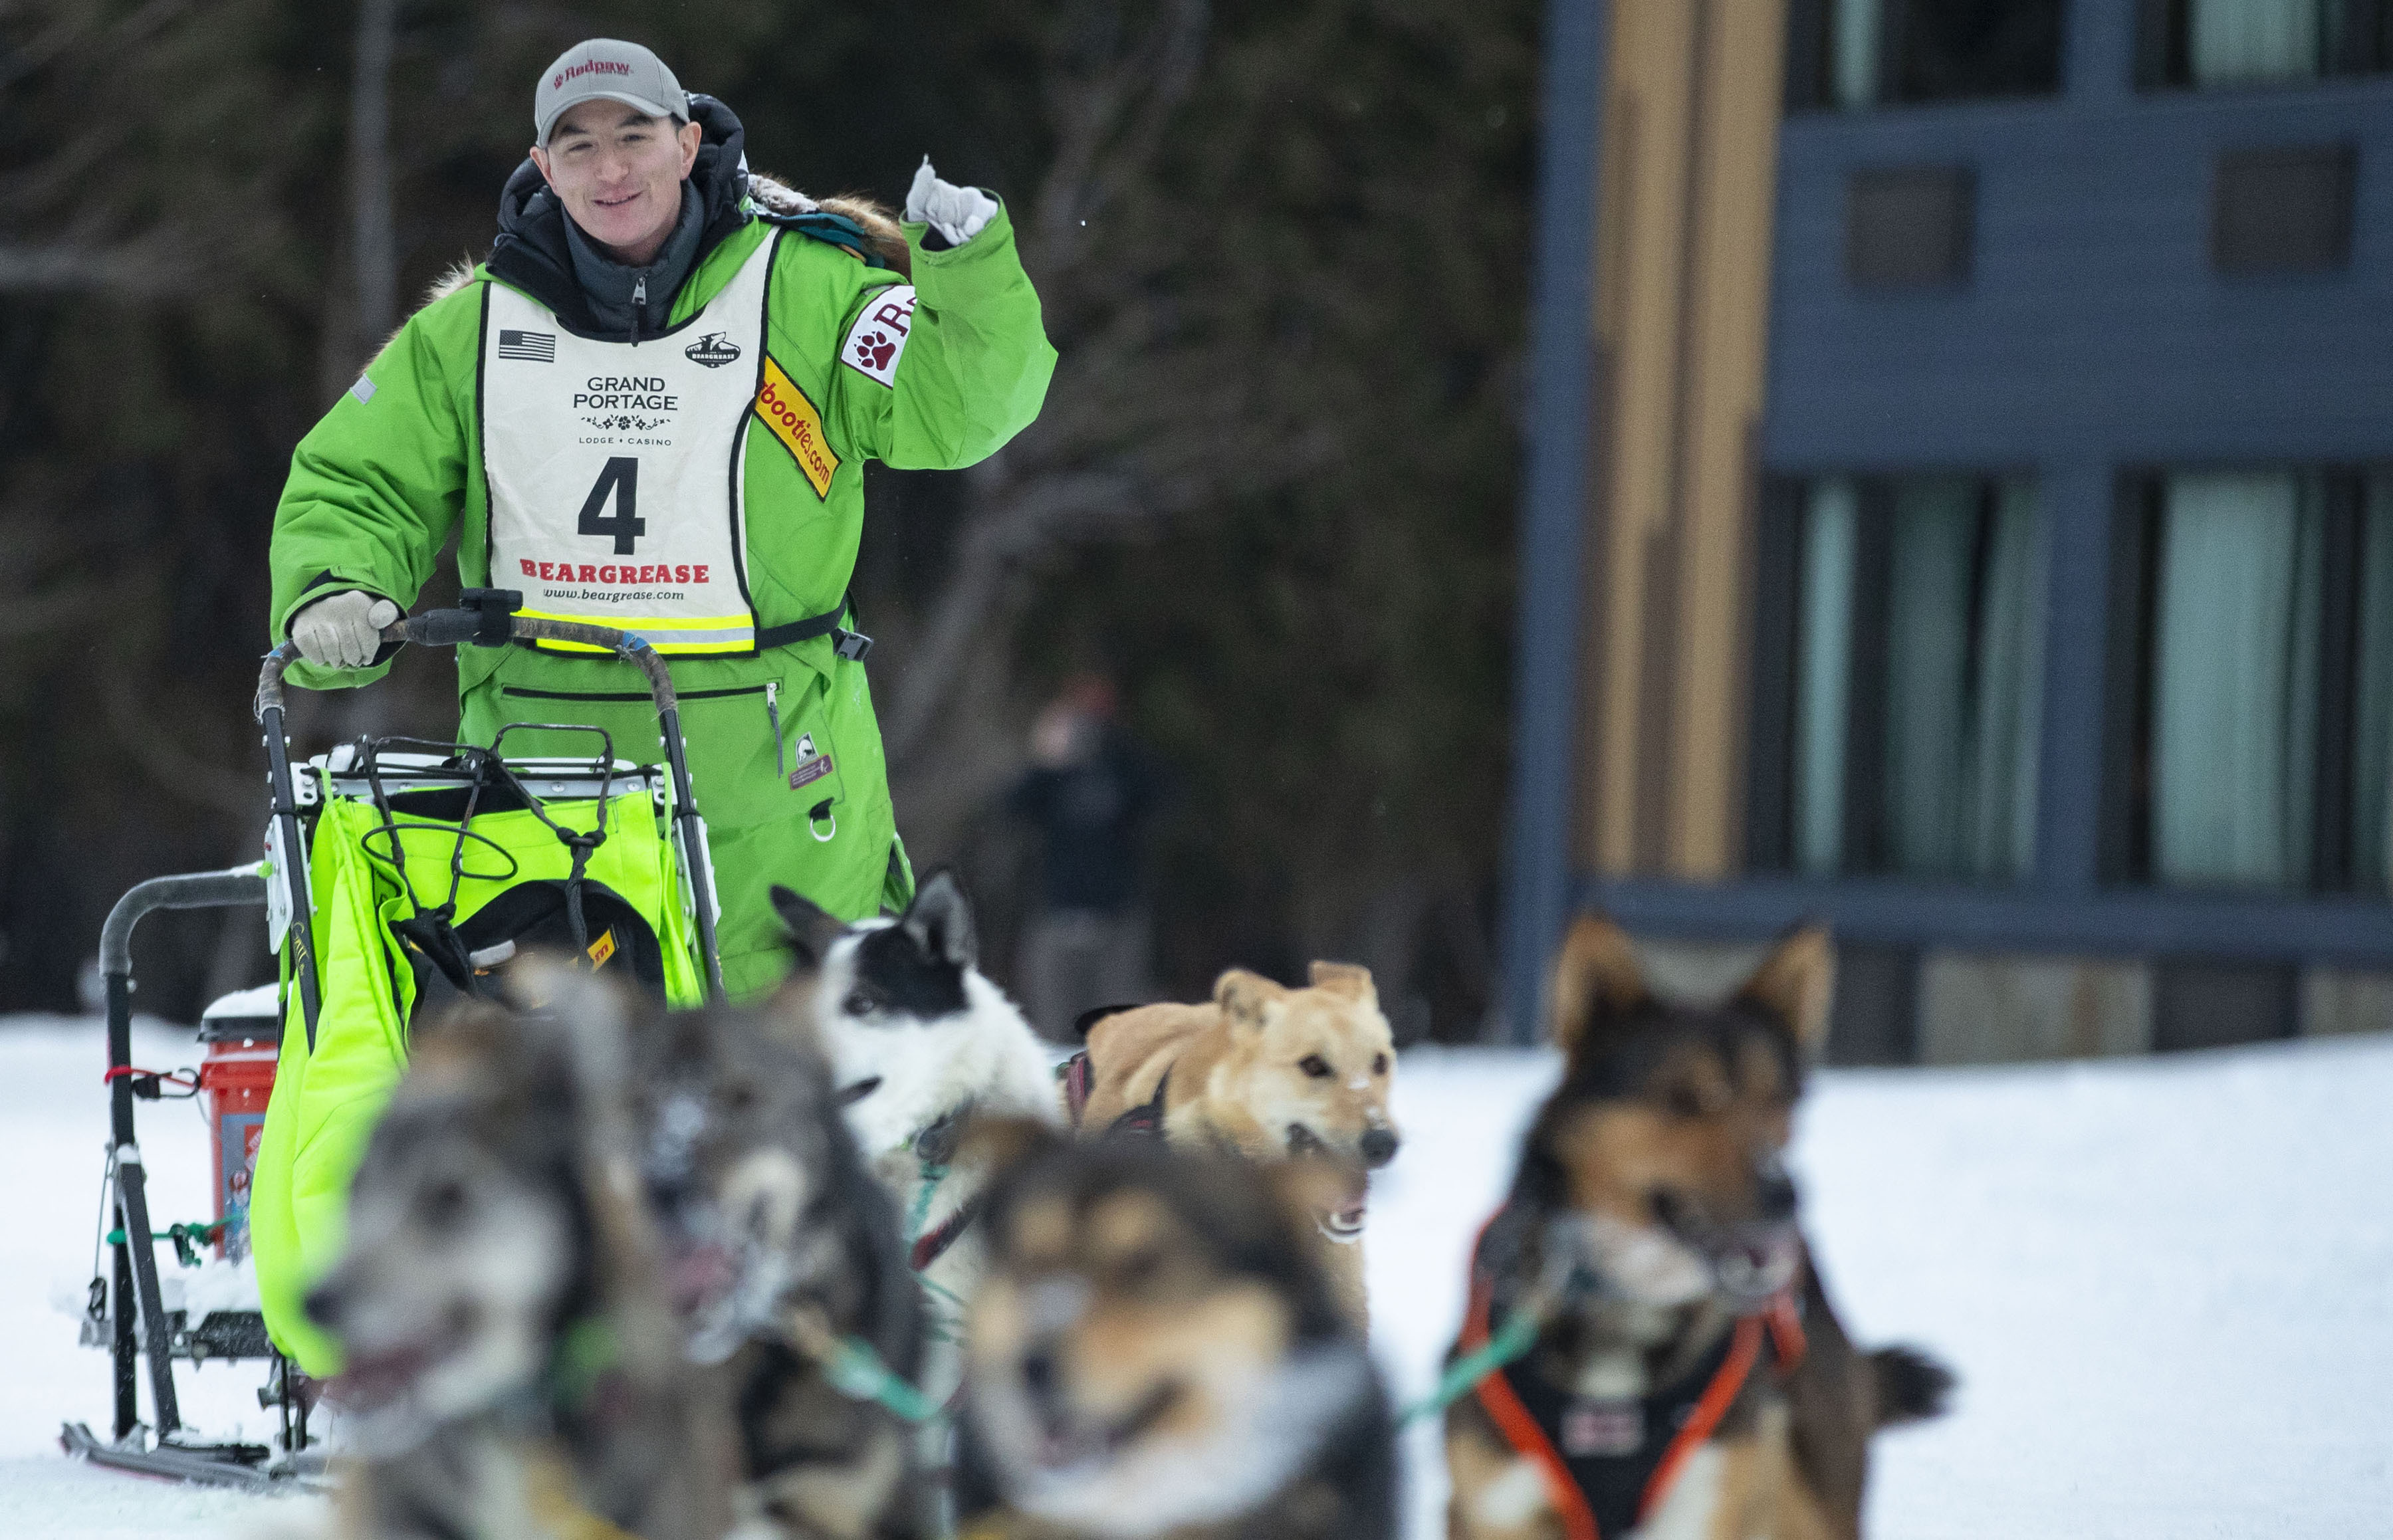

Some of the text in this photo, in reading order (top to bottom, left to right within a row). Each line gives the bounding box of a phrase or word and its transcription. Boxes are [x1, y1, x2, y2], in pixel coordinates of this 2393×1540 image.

[587, 376, 665, 392] GRAND
[573, 393, 678, 411] PORTAGE
[627, 437, 672, 446] CASINO
[760, 380, 830, 485] booties.com
[577, 456, 646, 556] 4
[519, 558, 710, 584] BEARGREASE
[542, 588, 685, 604] www.beargrease.com
